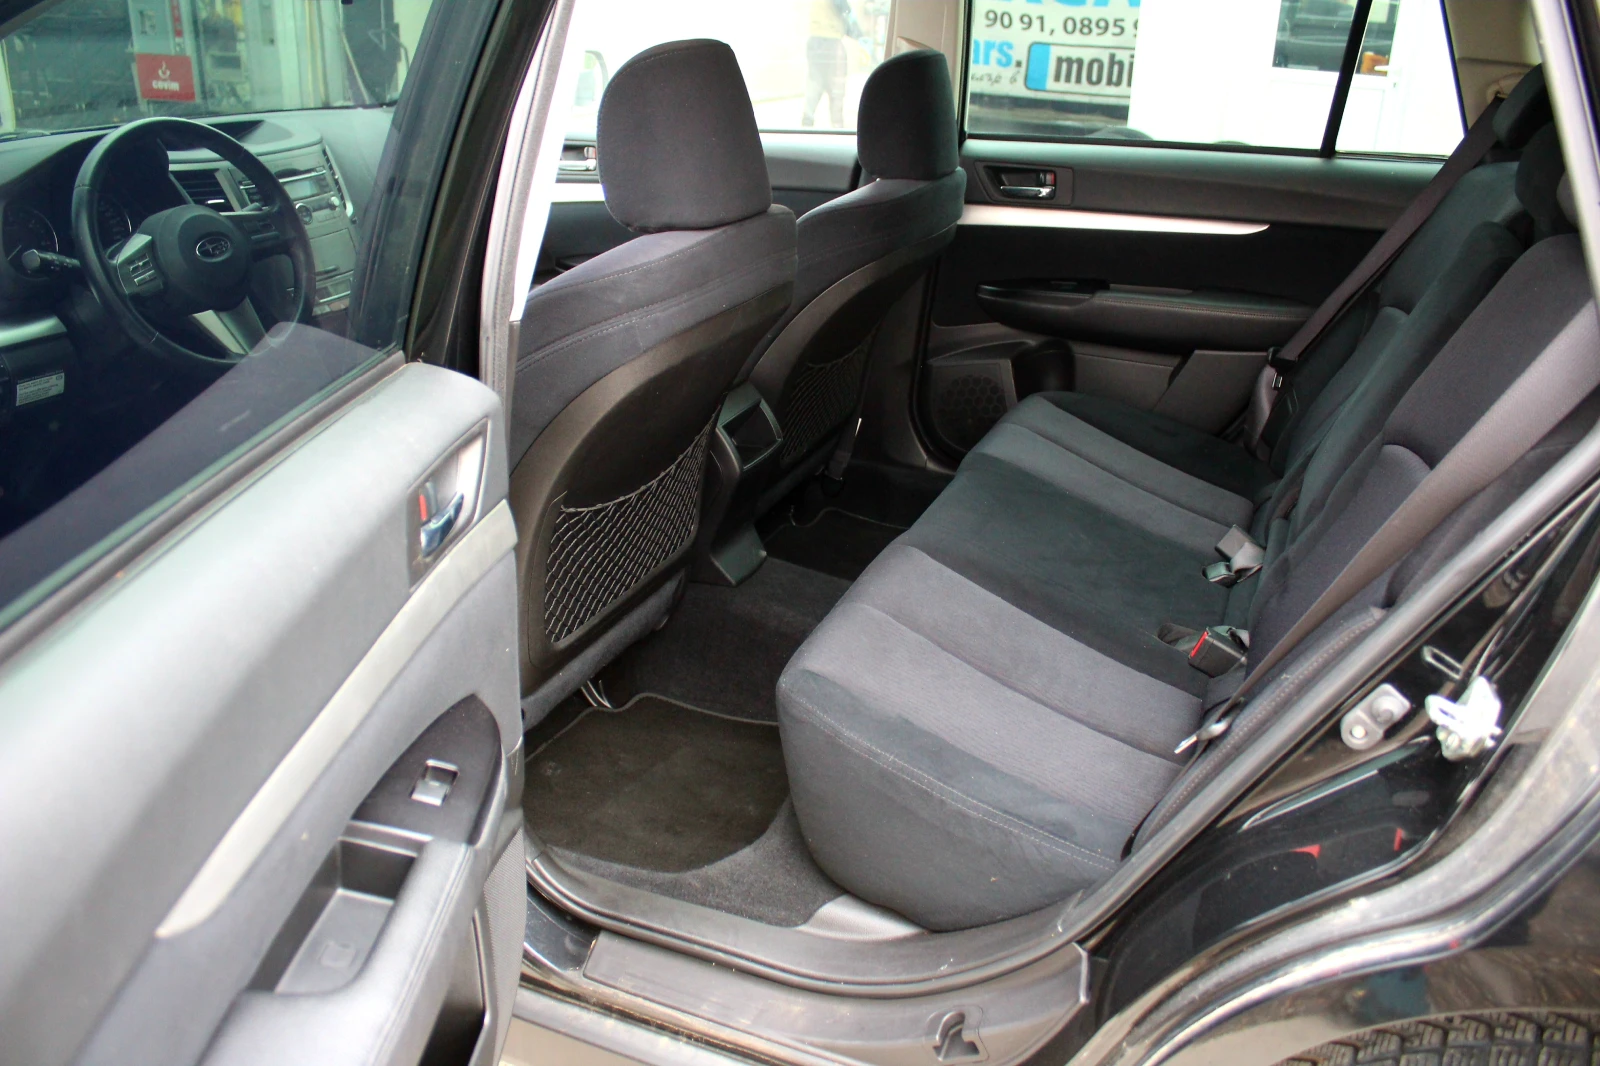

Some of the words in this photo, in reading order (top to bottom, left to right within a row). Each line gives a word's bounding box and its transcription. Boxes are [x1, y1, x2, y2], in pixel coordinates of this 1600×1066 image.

[984, 9, 1013, 29] 90
[1019, 13, 1055, 36] 91,
[1062, 16, 1126, 37] 0895
